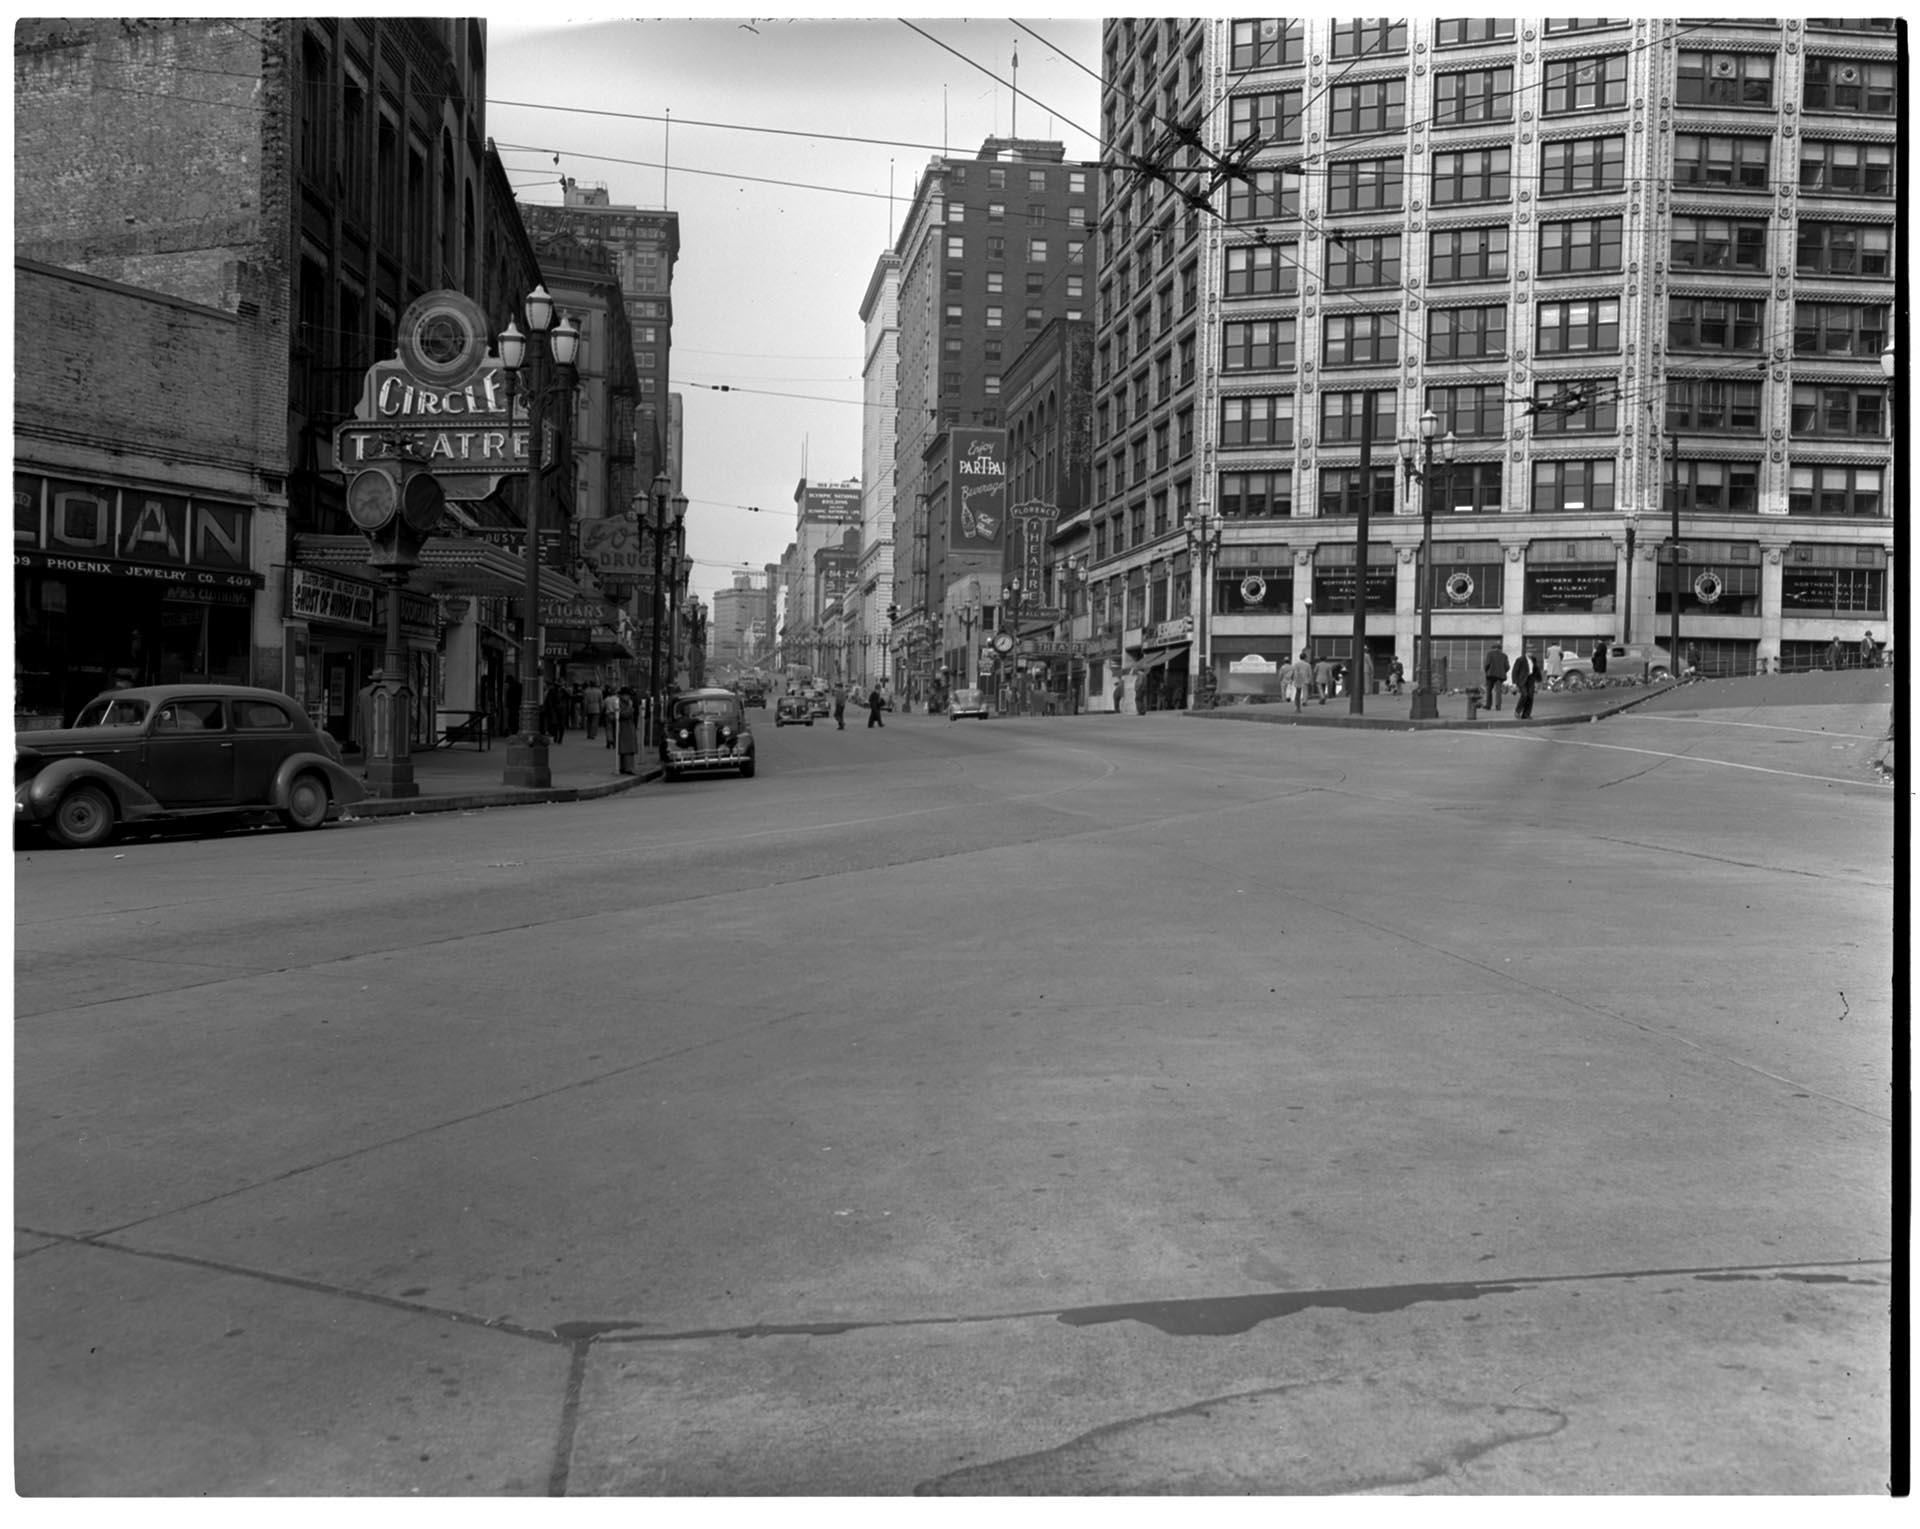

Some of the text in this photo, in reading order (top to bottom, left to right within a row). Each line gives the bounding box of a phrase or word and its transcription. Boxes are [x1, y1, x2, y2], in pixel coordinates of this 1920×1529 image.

[379, 369, 506, 416] CIRCLE
[350, 433, 531, 460] TEATRE
[1013, 506, 1057, 518] FLORENCE
[46, 559, 112, 574] PHOENIX
[126, 567, 187, 581] JEWELRY
[198, 573, 216, 584] CO.
[227, 576, 252, 586] 409
[1029, 520, 1041, 602] THEATRE
[548, 603, 604, 618] CIGARS
[546, 647, 569, 656] OTEL
